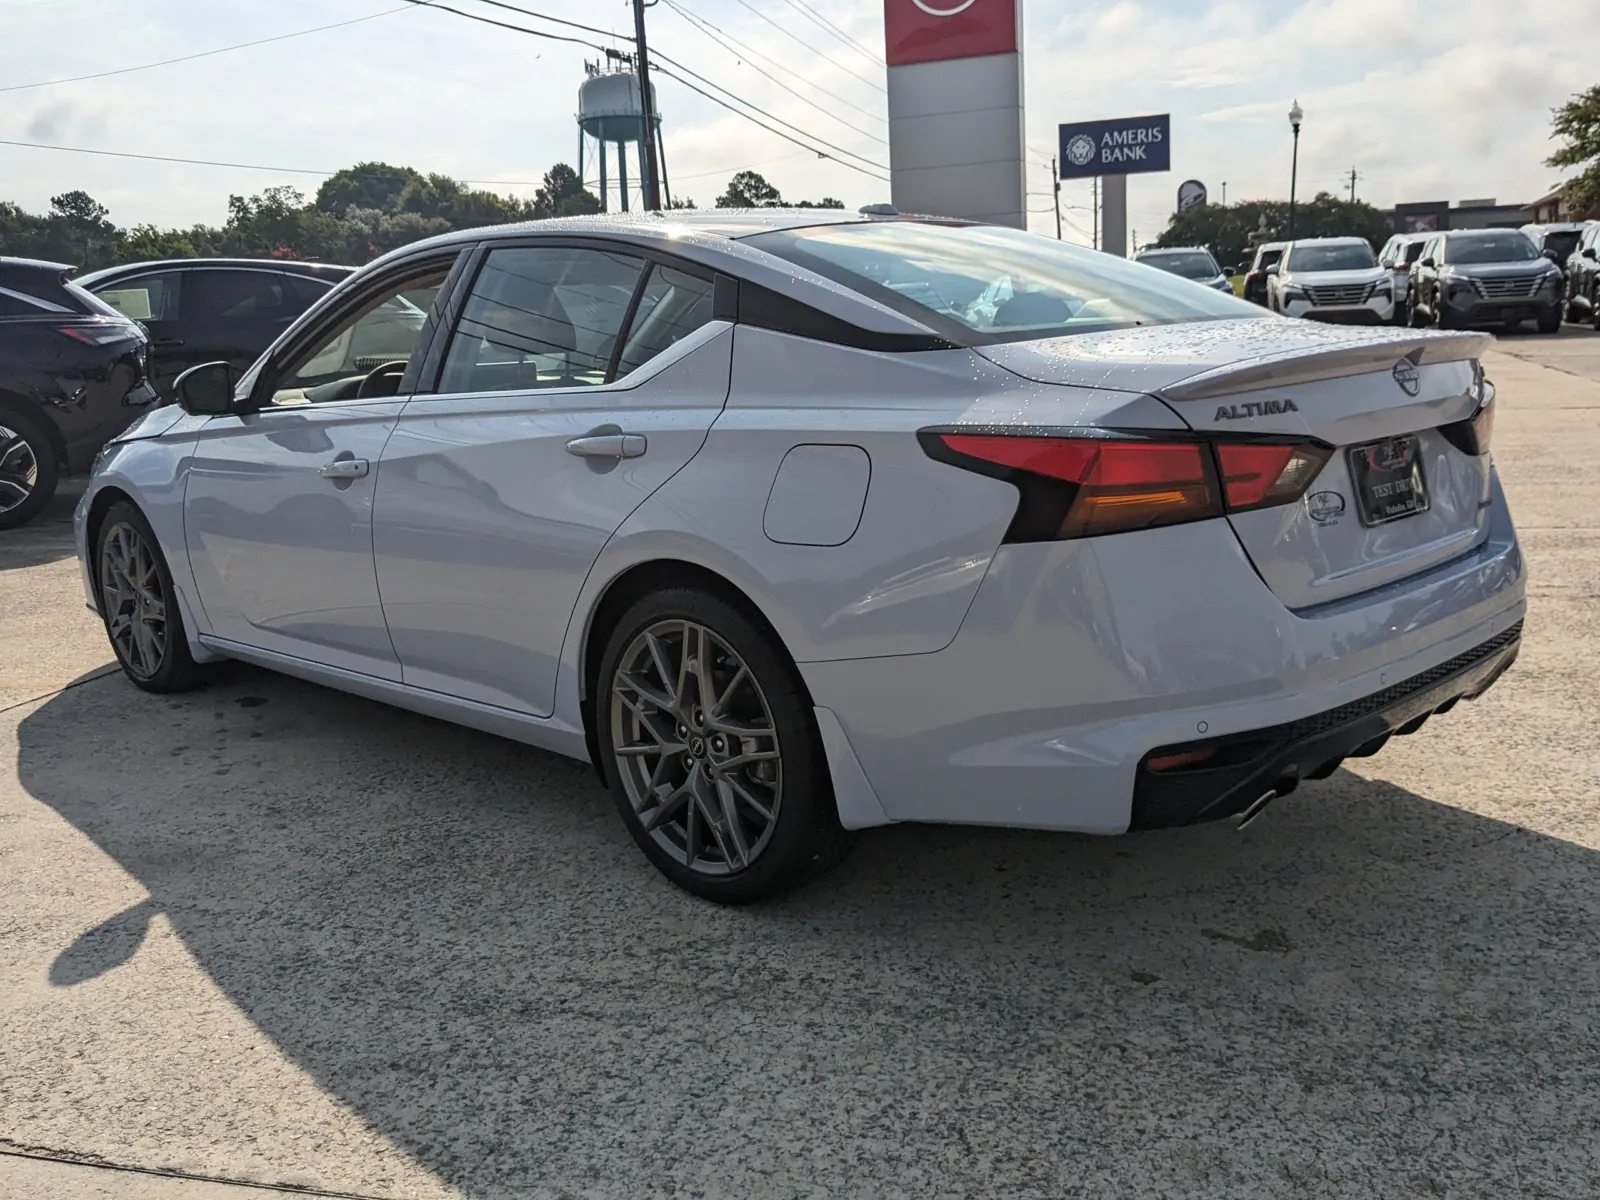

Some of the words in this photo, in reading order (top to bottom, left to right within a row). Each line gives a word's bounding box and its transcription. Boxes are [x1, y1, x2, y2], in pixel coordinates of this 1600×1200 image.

[1101, 127, 1162, 147] AMERIS
[1101, 145, 1147, 163] BANK
[1214, 399, 1299, 421] ALTIMA
[1372, 482, 1393, 498] TEST
